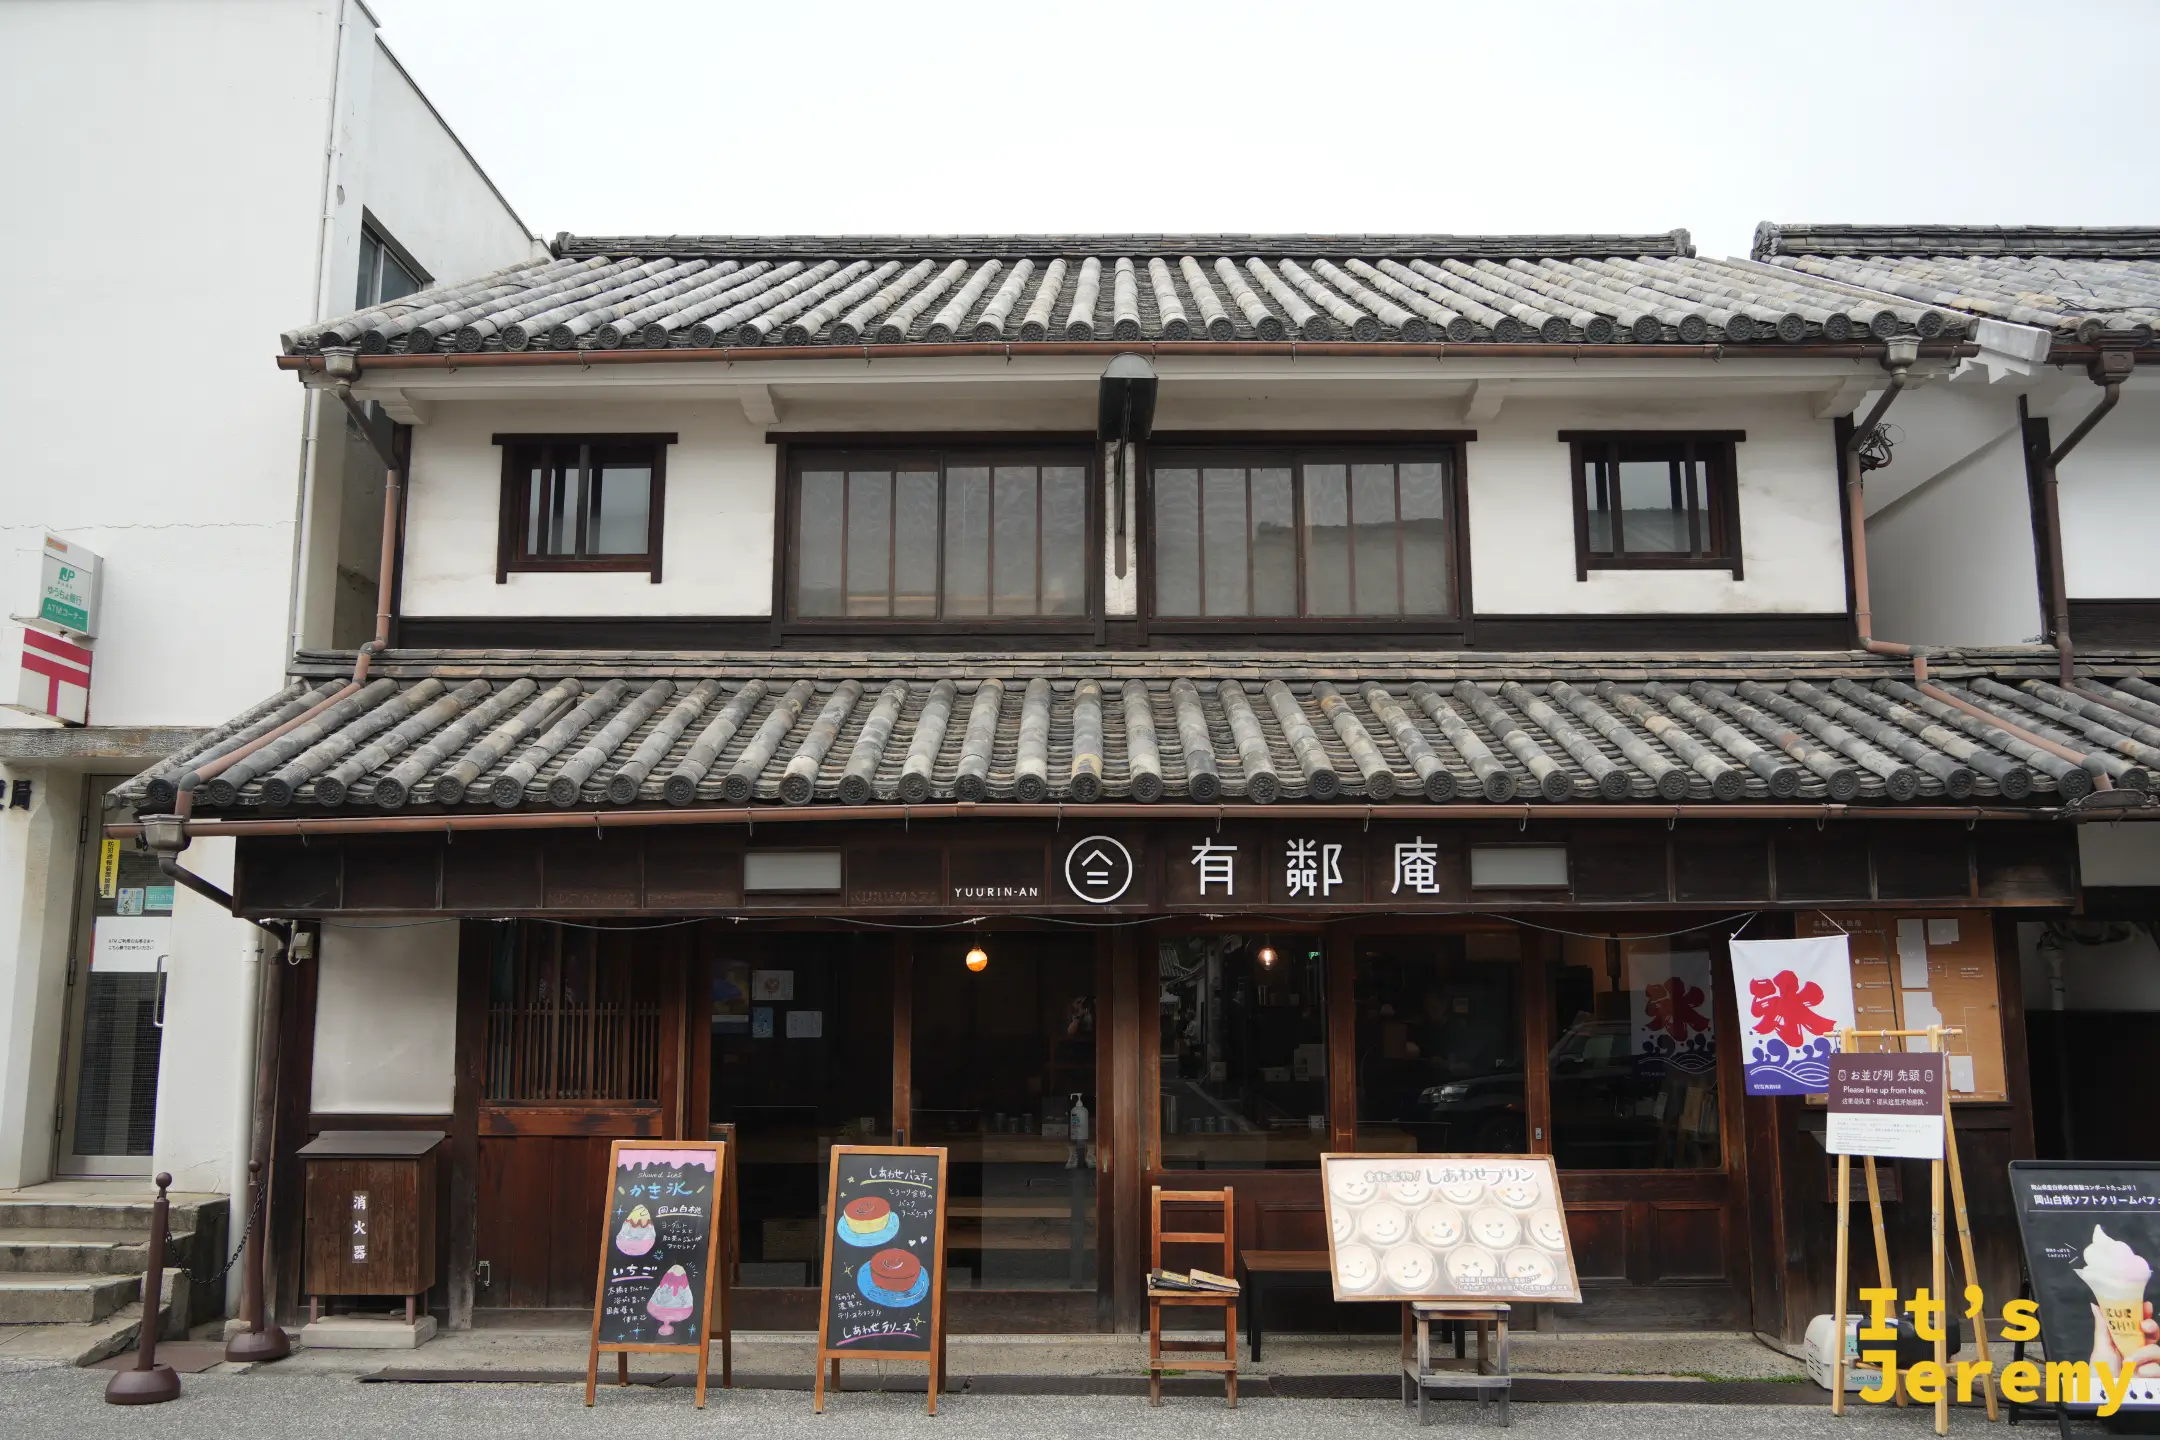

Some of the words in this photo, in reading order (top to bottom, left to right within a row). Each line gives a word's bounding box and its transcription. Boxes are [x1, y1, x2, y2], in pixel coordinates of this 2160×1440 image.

[955, 887, 1038, 897] YUURIN-AN
[1749, 969, 1837, 1047] 氷
[1851, 1069, 1893, 1081] お並び列
[1897, 1069, 1920, 1081] 先頭
[1843, 1085, 1865, 1094] Please
[1865, 1086, 1878, 1094] line
[1890, 1086, 1907, 1094] from
[1908, 1086, 1927, 1095] here.
[869, 1166, 933, 1183] しあわせバスチー
[1426, 1168, 1535, 1186] しあわせプリン
[630, 1181, 693, 1199] かき氷
[658, 1205, 702, 1215] 岡山白桃
[898, 1200, 915, 1208] バスク
[353, 1195, 367, 1260] 消火器
[662, 1221, 687, 1229] ヨーグルト
[613, 1264, 658, 1276] いちご
[843, 1321, 912, 1338] しあわせテリーヌ
